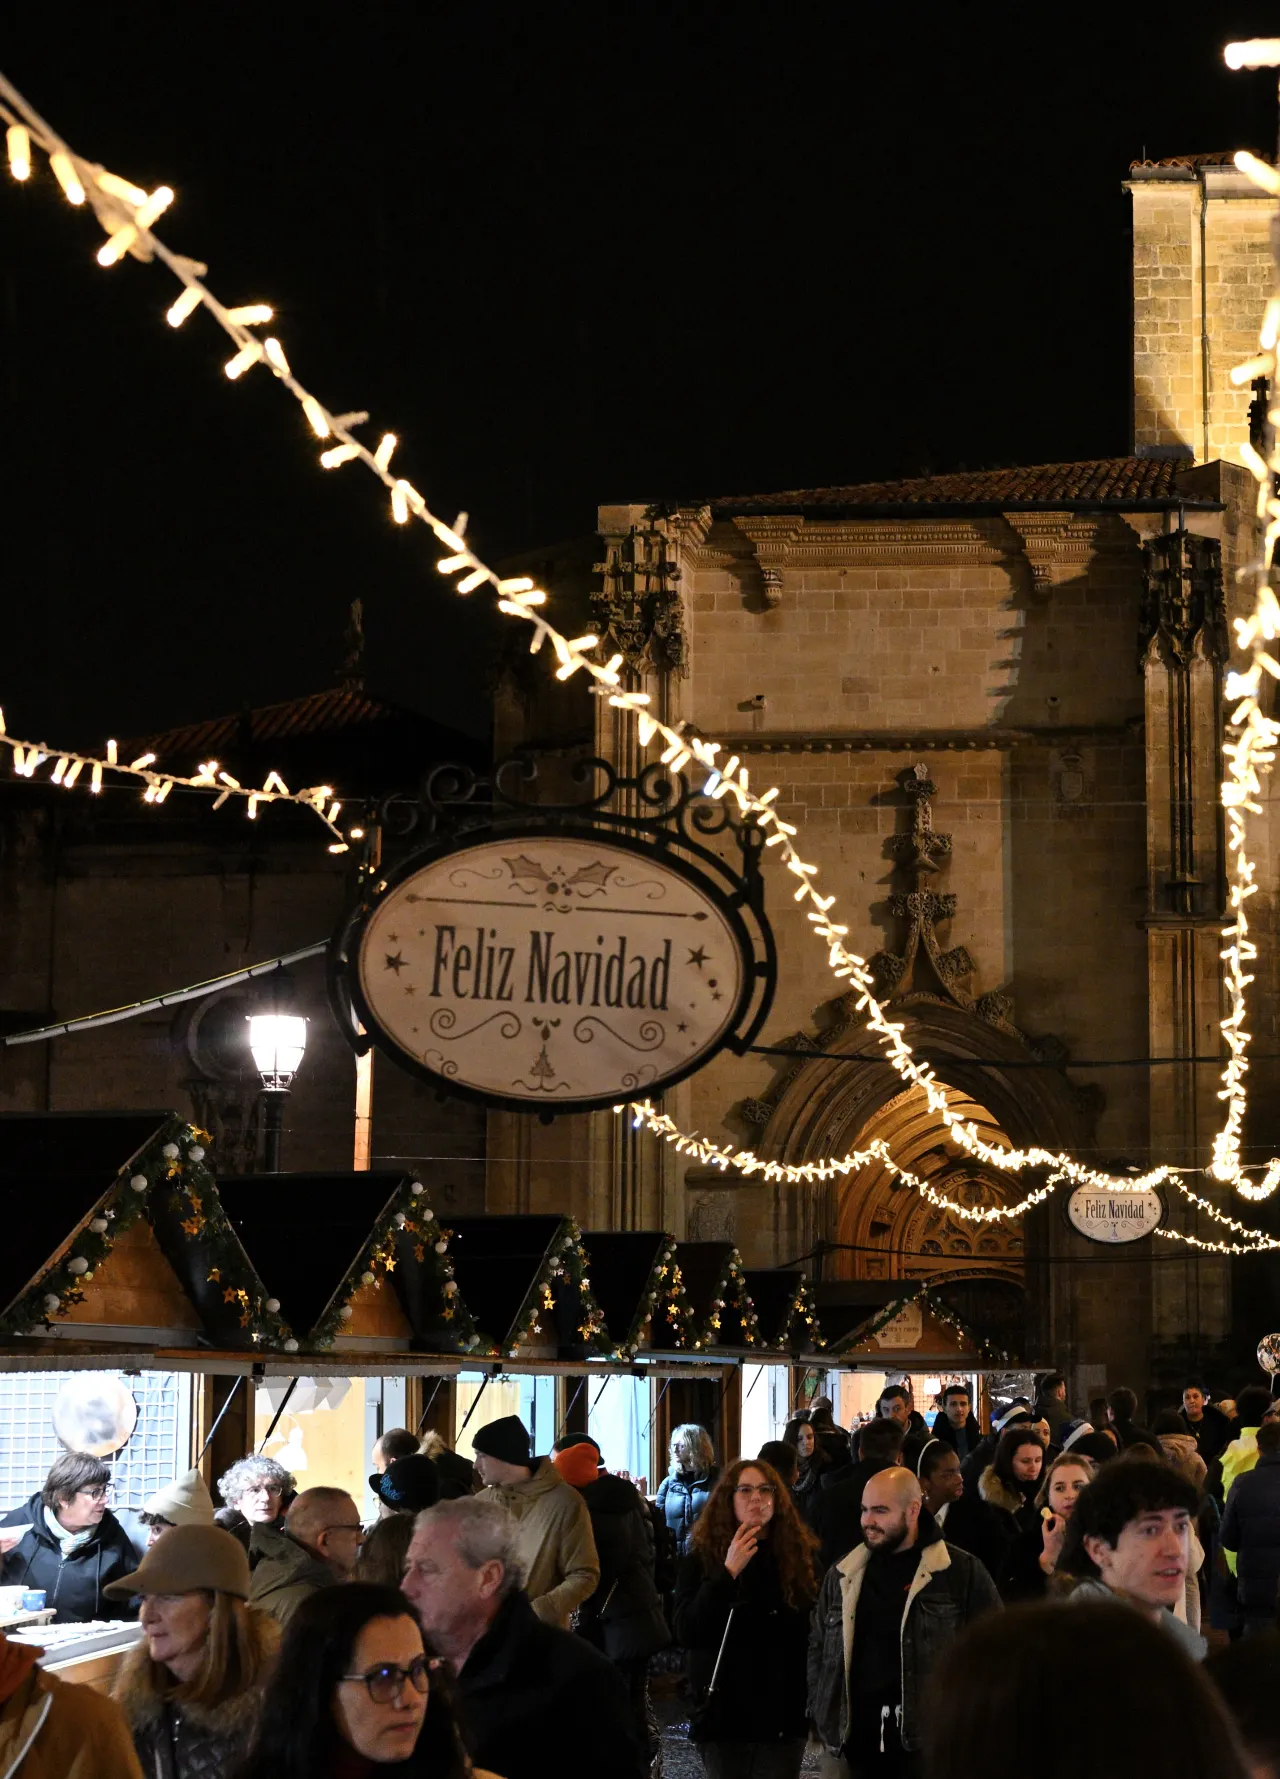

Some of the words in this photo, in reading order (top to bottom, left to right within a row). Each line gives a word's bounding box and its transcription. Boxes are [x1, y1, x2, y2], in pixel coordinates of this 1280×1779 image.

[429, 925, 515, 1001] Feliz
[524, 930, 672, 1011] Navidad
[1085, 1199, 1107, 1219] Feliz
[1108, 1199, 1144, 1219] Navidad
